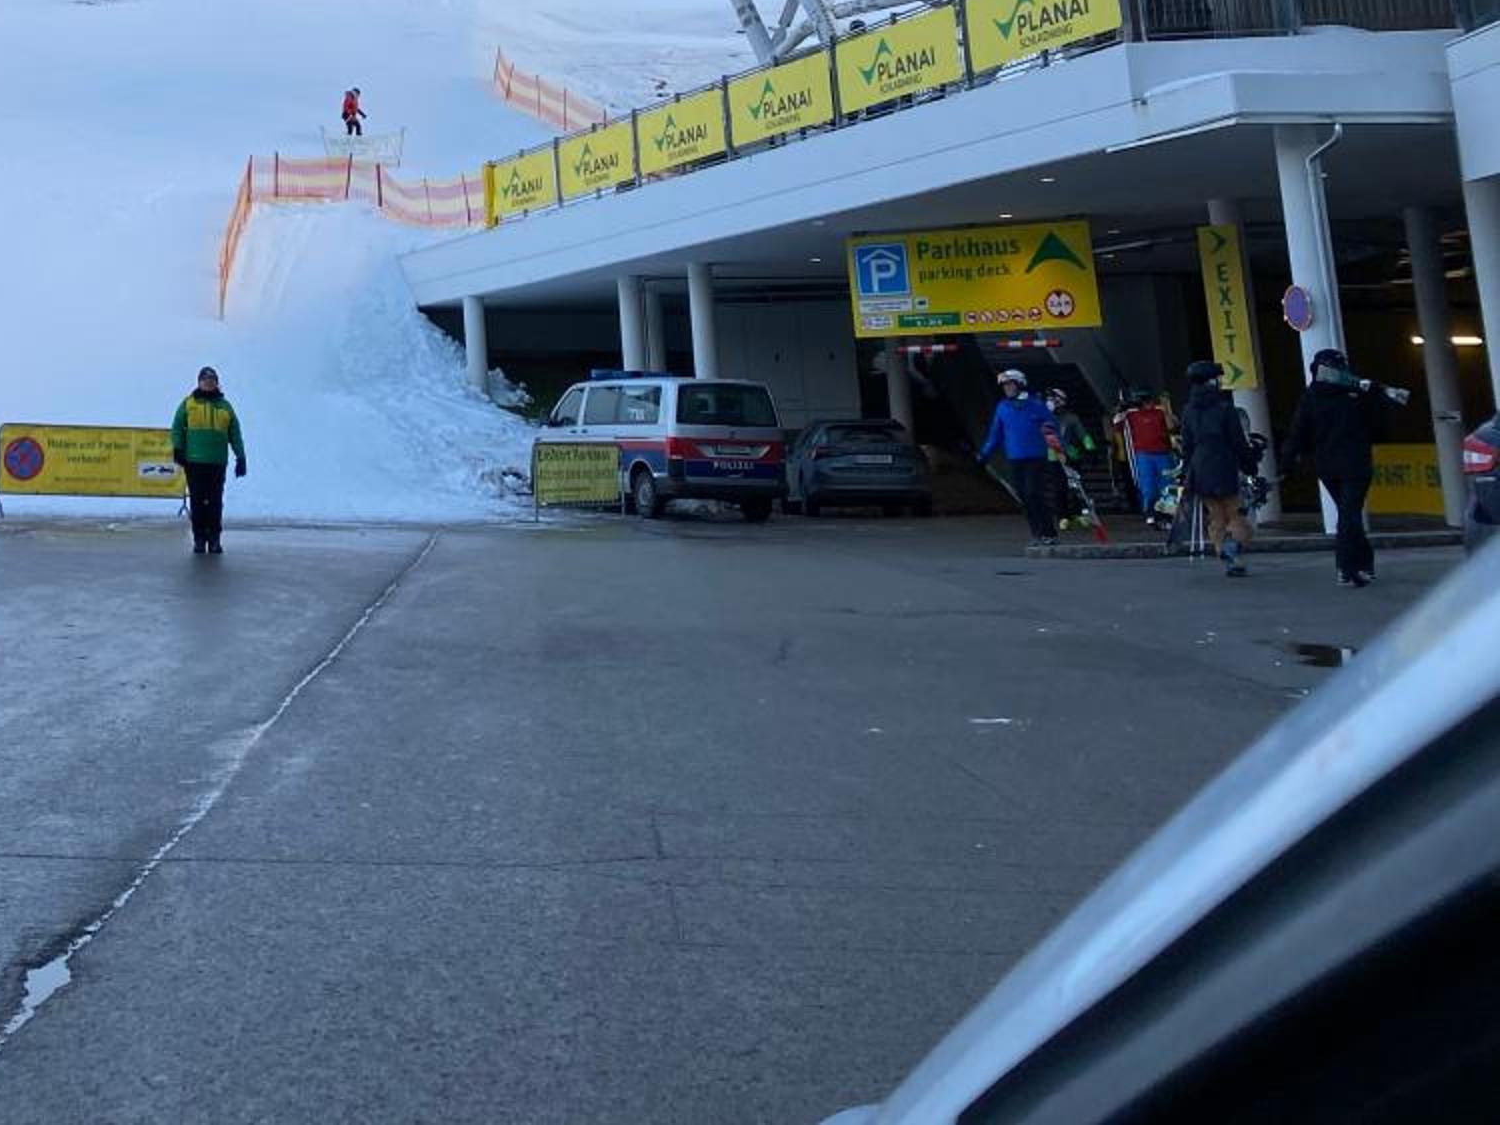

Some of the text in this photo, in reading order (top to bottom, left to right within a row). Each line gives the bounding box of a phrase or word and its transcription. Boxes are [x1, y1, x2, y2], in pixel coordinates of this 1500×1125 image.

[877, 47, 935, 81] PLANAI
[763, 87, 813, 119] PLANAI
[666, 123, 708, 148] PLANAI
[583, 153, 619, 175] PLANAI
[916, 235, 1021, 261] Parkhaus
[919, 263, 1013, 284] parking deck
[1216, 263, 1237, 353] EXIT
[712, 460, 756, 471] POLIZEI
